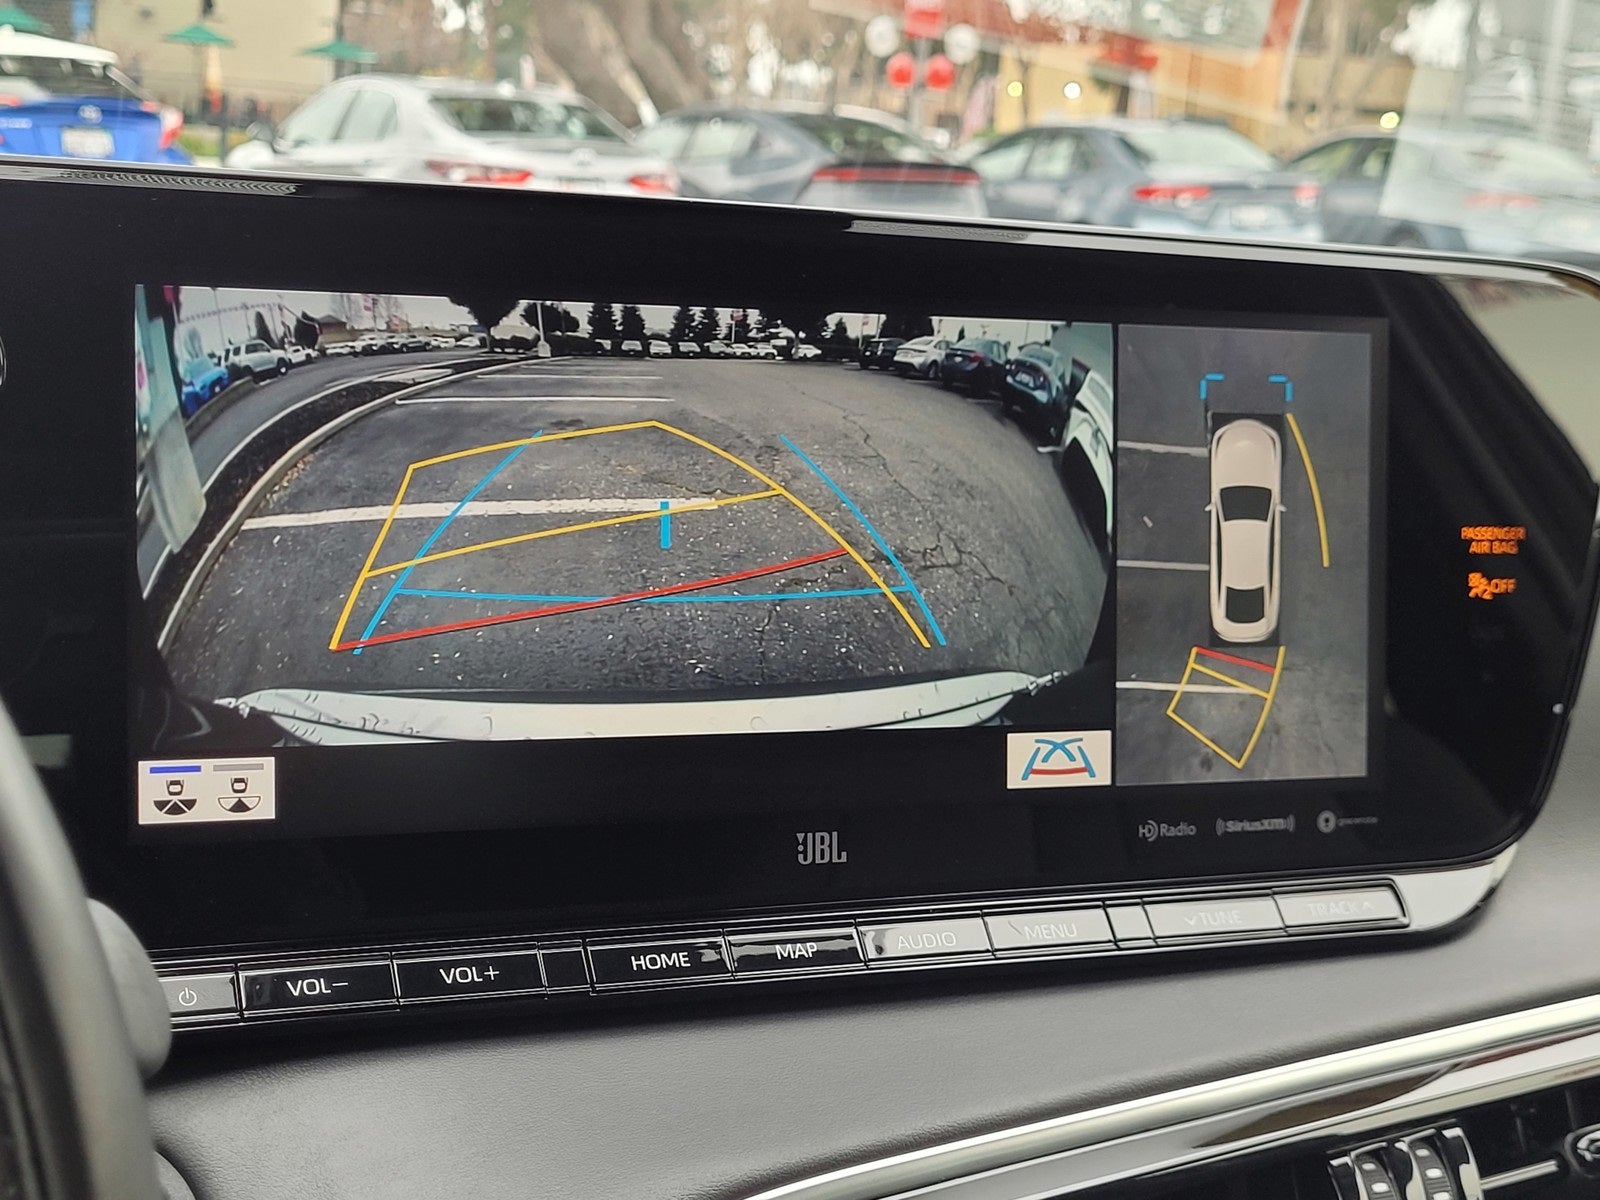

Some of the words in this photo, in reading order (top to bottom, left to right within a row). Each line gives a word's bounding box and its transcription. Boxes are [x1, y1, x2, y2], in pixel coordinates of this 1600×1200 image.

[1461, 526, 1526, 540] PASSENGER
[1469, 540, 1491, 554] AIR
[1492, 540, 1518, 554] BAG
[1490, 578, 1516, 594] OFF
[1159, 821, 1197, 837] Radio
[796, 831, 848, 865] JBL
[1198, 909, 1243, 927] TUNE
[1308, 902, 1360, 918] TRACK
[897, 931, 957, 950] AUDIO
[1023, 922, 1078, 941] MENU
[774, 942, 818, 960] MAP
[630, 951, 692, 971] HOME
